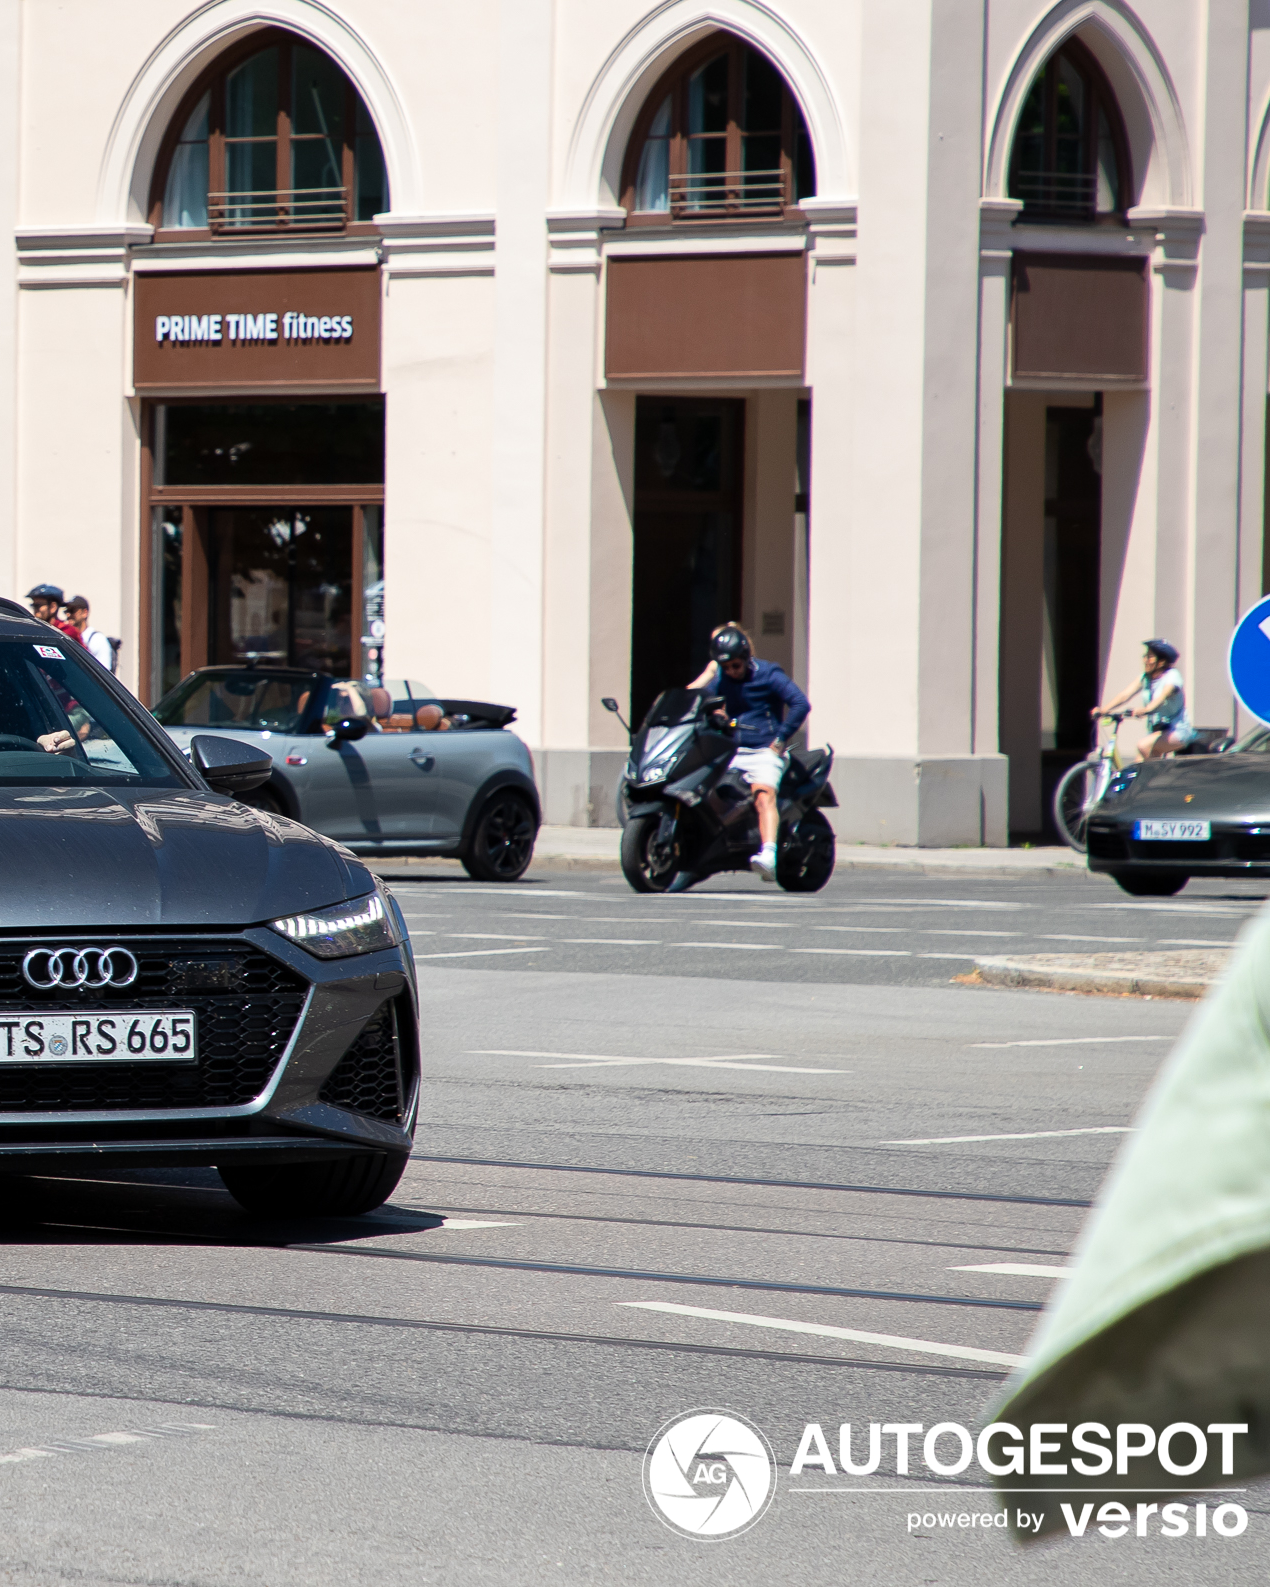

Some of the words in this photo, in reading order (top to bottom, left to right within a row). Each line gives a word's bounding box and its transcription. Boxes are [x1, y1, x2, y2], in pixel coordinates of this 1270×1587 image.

[155, 315, 223, 342] PRIME
[226, 313, 279, 340] TIME
[282, 311, 353, 339] fitness
[1144, 824, 1153, 836] M
[1161, 823, 1177, 836] SY
[1179, 824, 1204, 836] 992
[0, 1020, 45, 1056] TS
[71, 1019, 118, 1056] RS
[127, 1018, 191, 1055] 665
